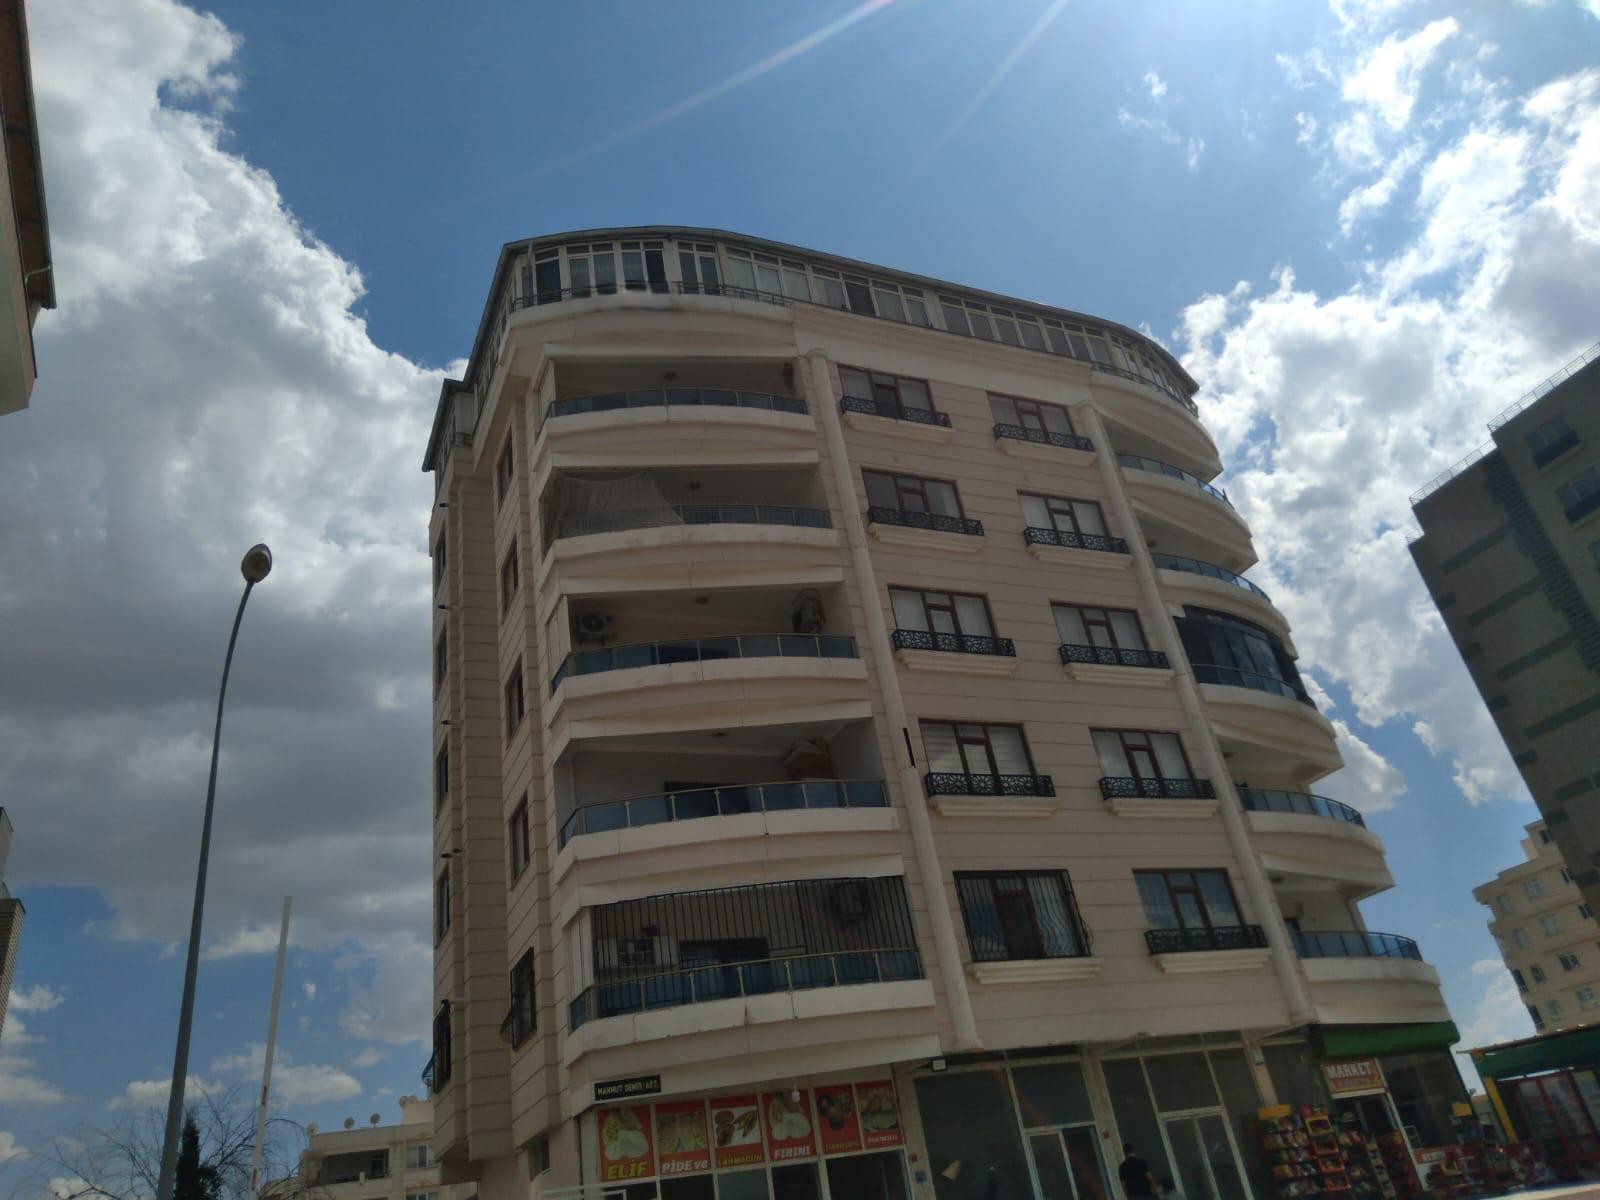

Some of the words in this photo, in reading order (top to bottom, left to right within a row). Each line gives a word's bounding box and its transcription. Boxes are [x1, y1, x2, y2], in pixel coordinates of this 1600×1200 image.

[1326, 1062, 1371, 1079] MARKET
[607, 1159, 648, 1180] ELİF
[661, 1159, 693, 1173] PİDE
